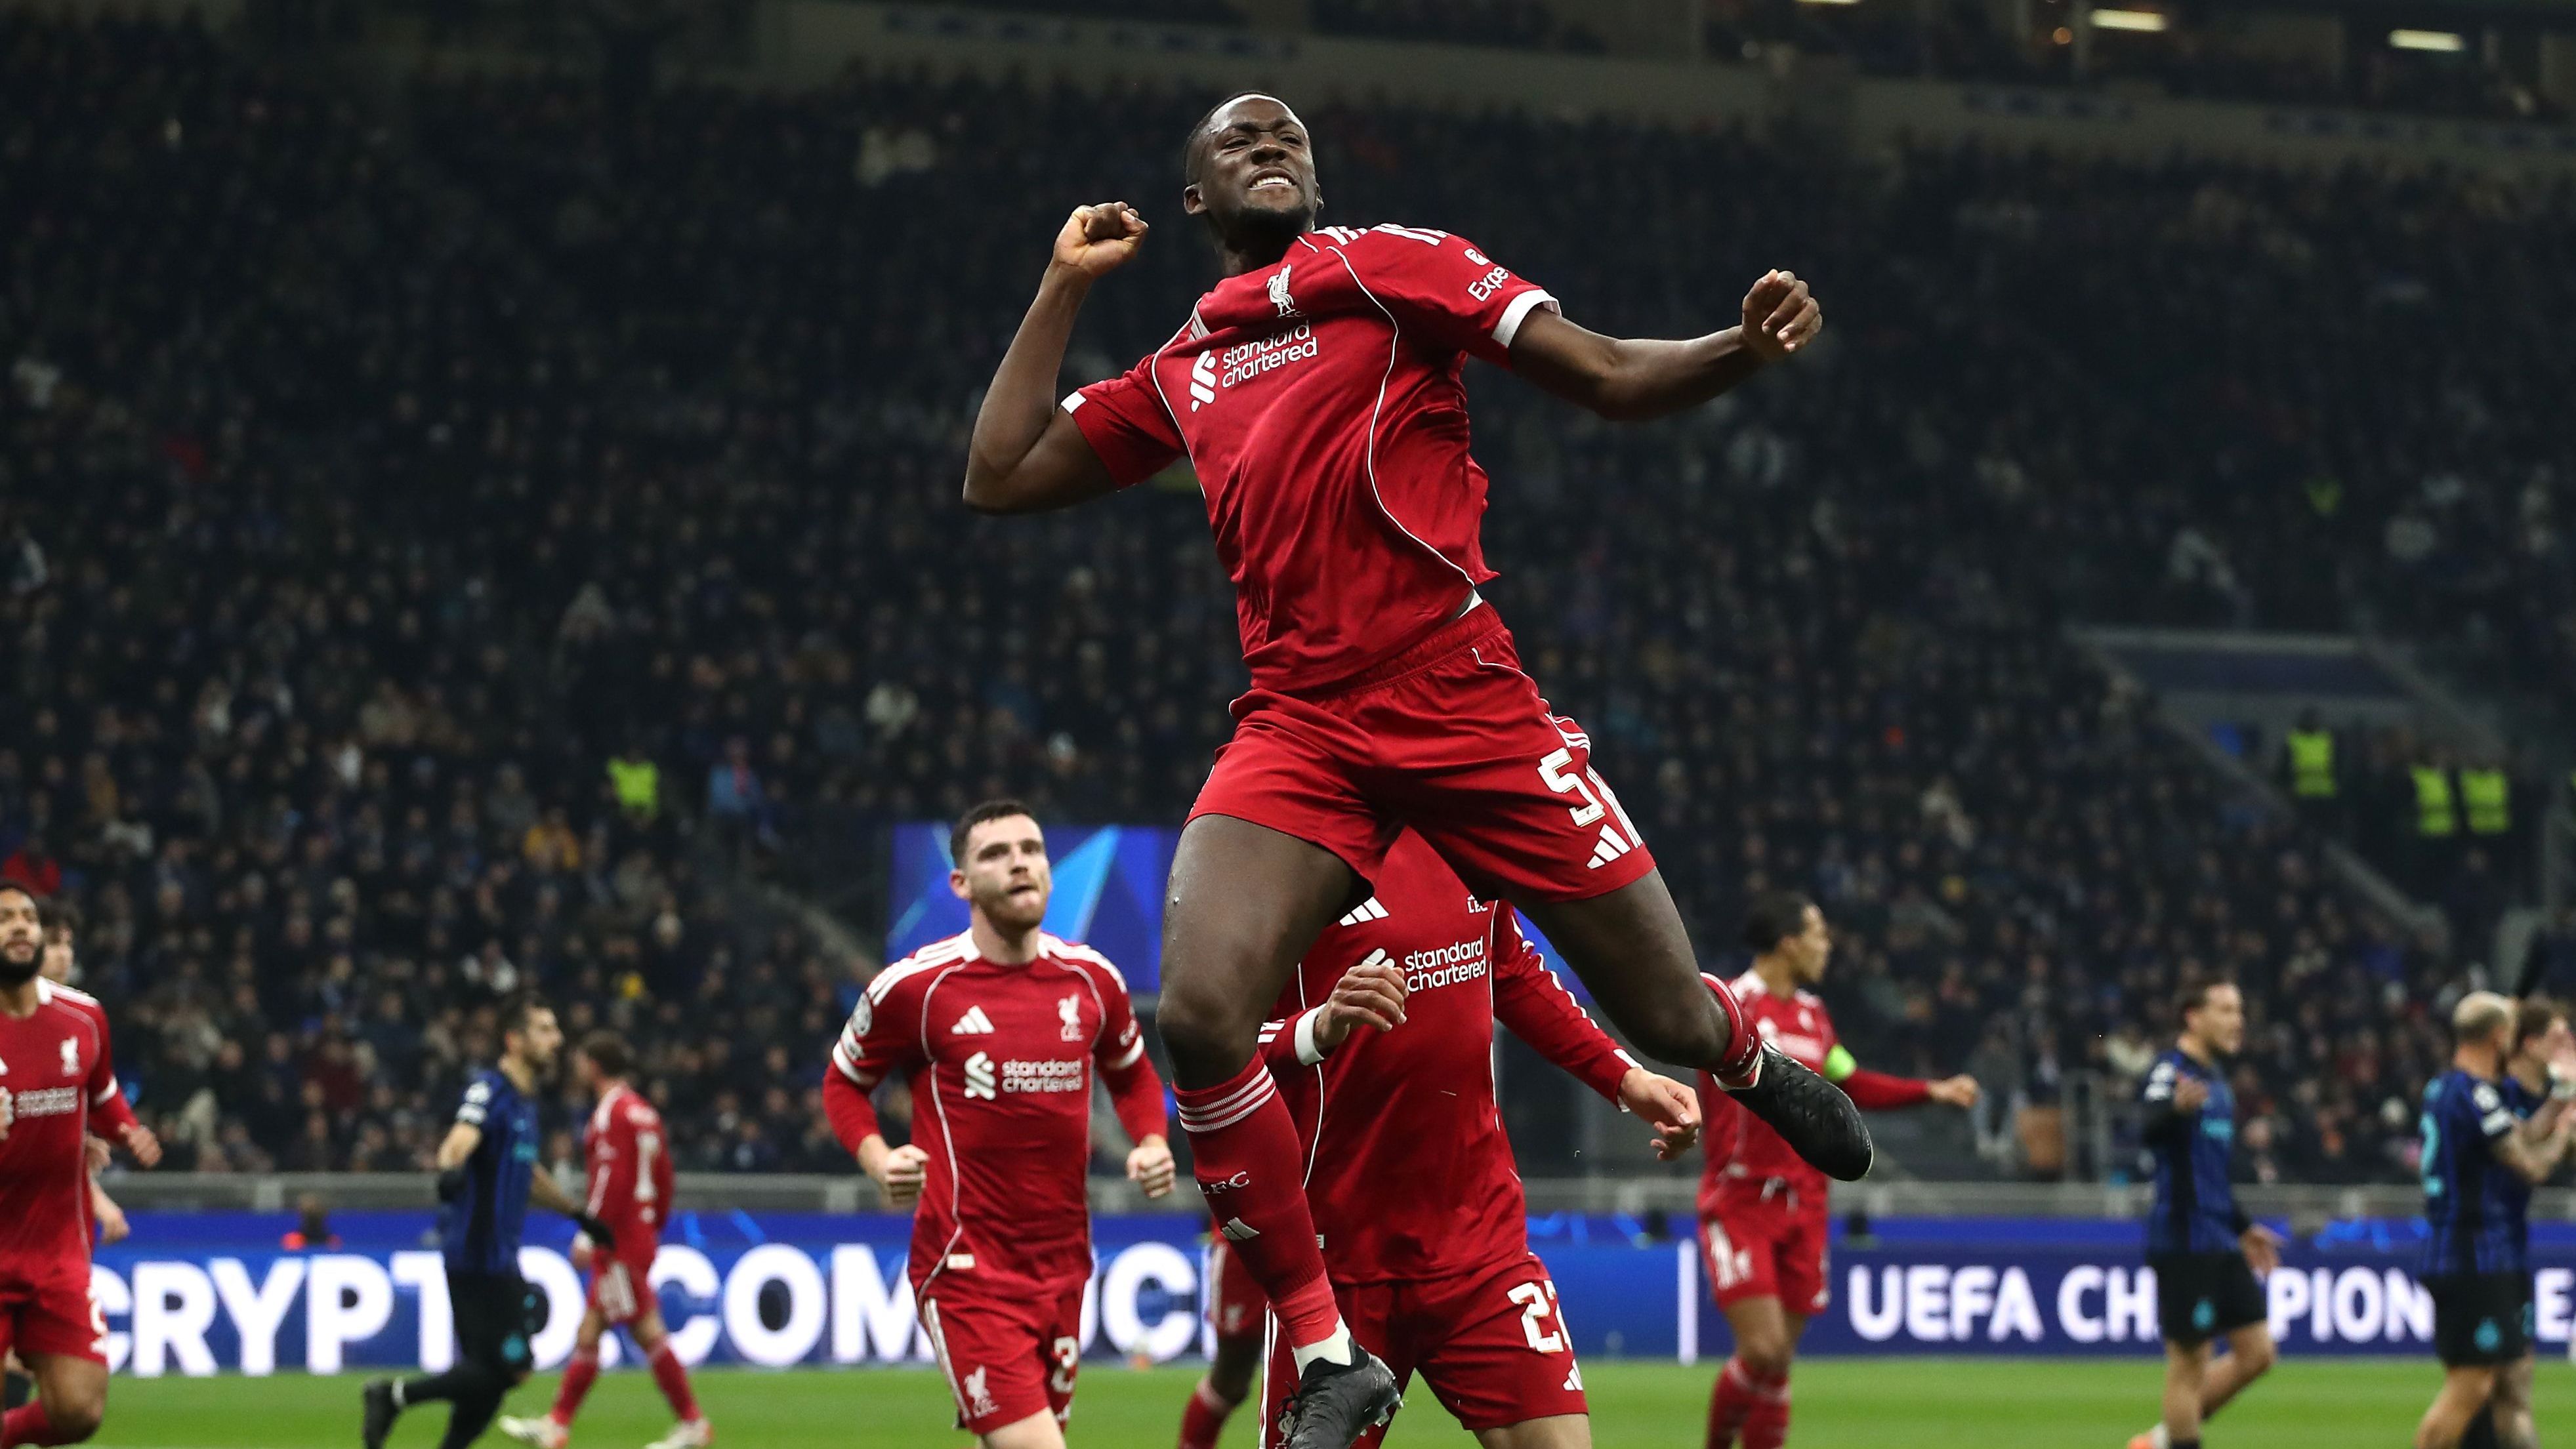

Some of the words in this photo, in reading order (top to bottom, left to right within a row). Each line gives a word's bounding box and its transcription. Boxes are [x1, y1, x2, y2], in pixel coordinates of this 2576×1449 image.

[1222, 319, 1310, 370] standard
[1222, 337, 1318, 388] chartered
[1537, 746, 1606, 828] 5
[1405, 935, 1484, 972] standard
[1407, 955, 1487, 992] chartered
[1847, 1263, 2045, 1343] UEFA
[2057, 1264, 2436, 1343] CHPION
